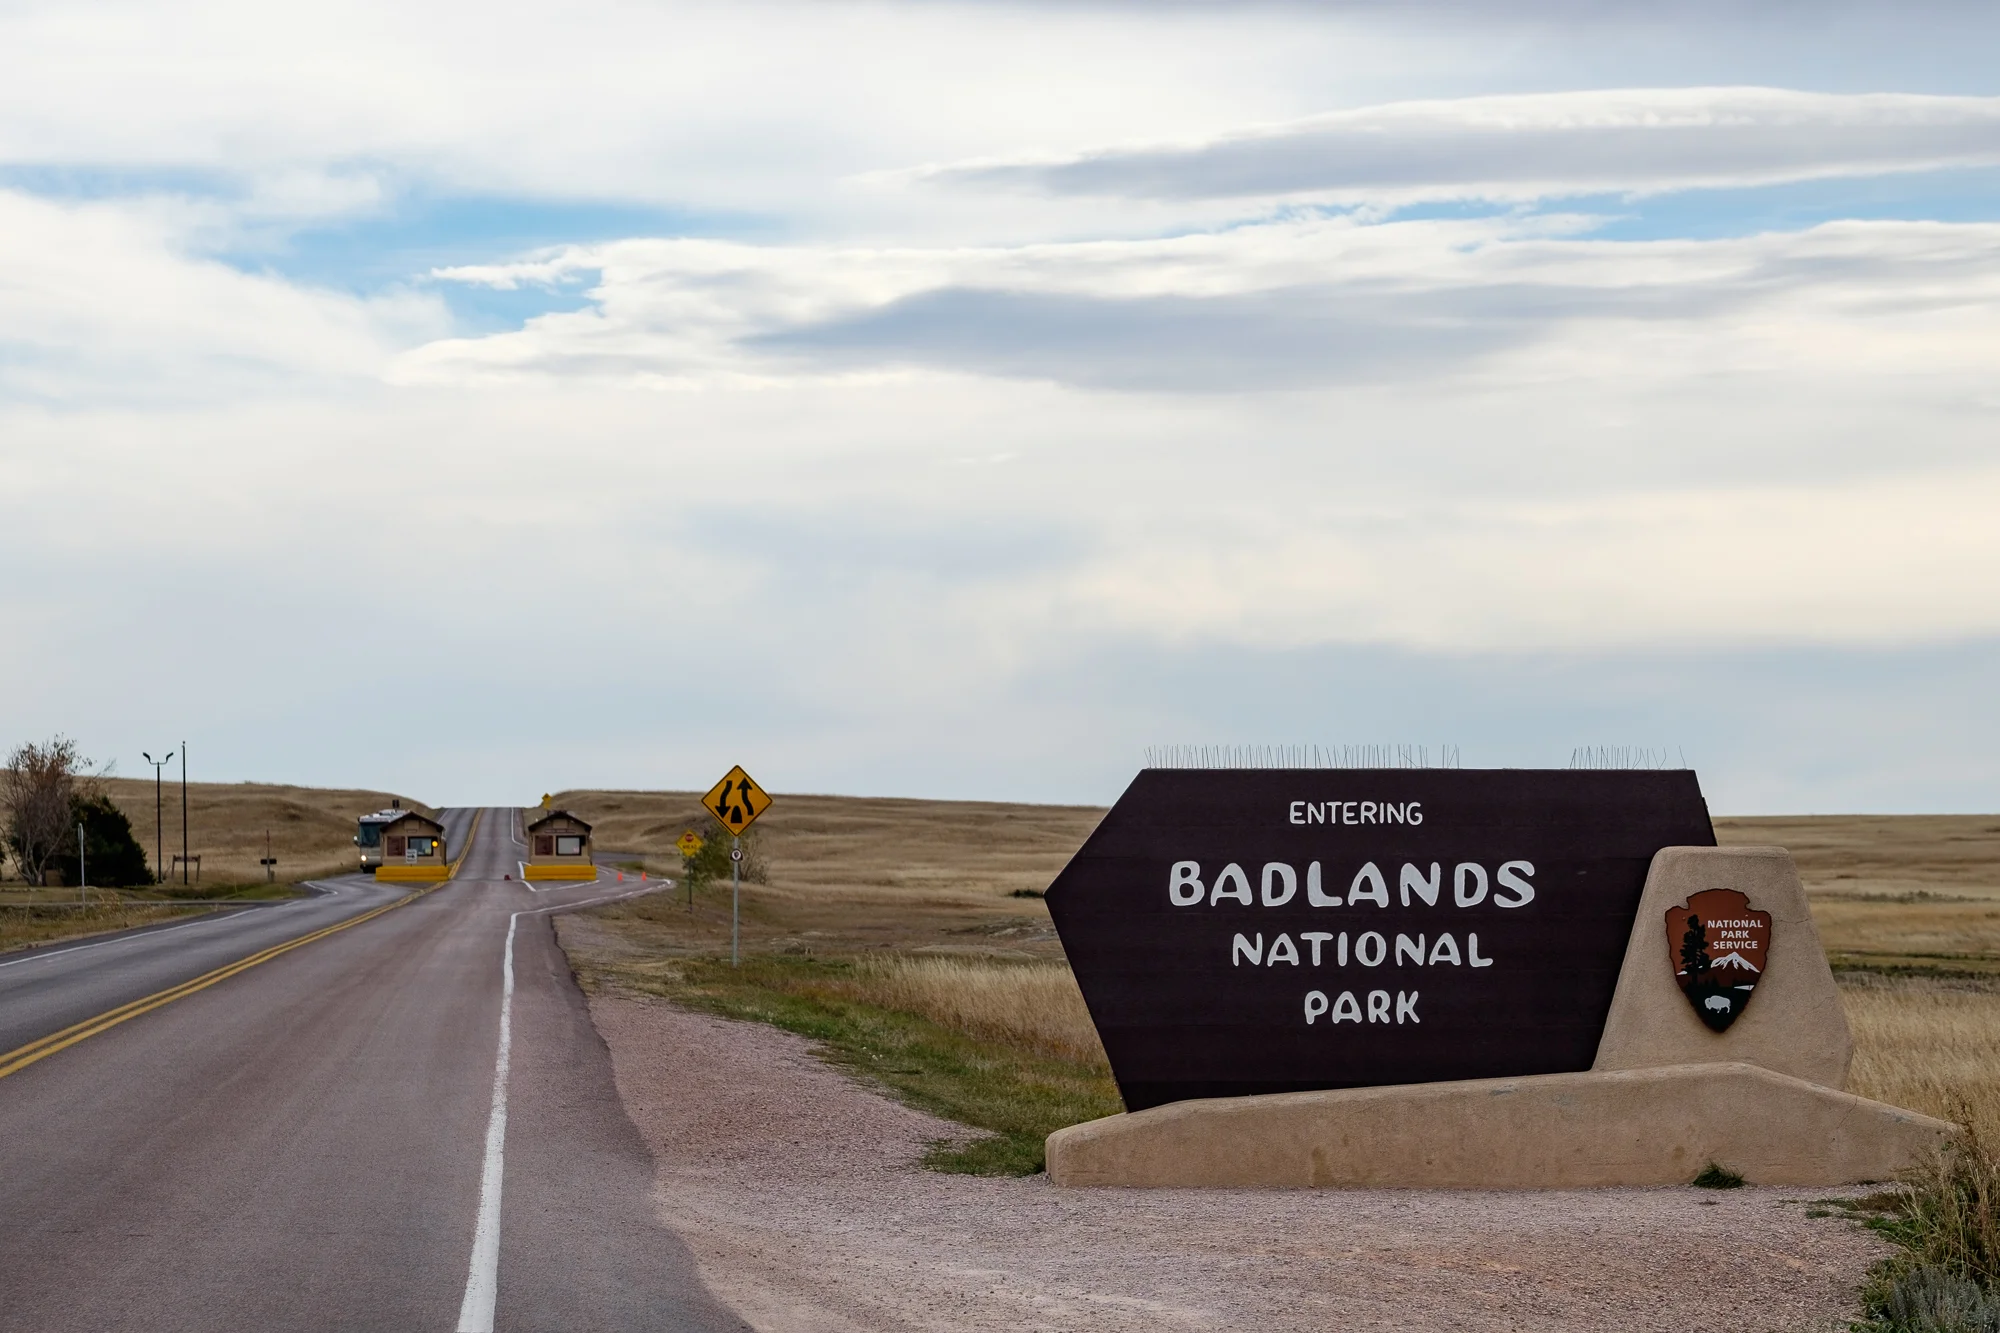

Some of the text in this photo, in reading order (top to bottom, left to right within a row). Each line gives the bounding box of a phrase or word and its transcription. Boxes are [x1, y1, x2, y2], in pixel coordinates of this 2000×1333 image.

[1289, 800, 1423, 826] ENTERING
[1168, 860, 1536, 909] BADLANDS
[1707, 919, 1763, 928] NATIONAL
[1721, 930, 1749, 939] PARK
[1232, 930, 1494, 968] NATIONAL
[1713, 940, 1758, 949] SERVICE
[1304, 989, 1421, 1025] PARK
